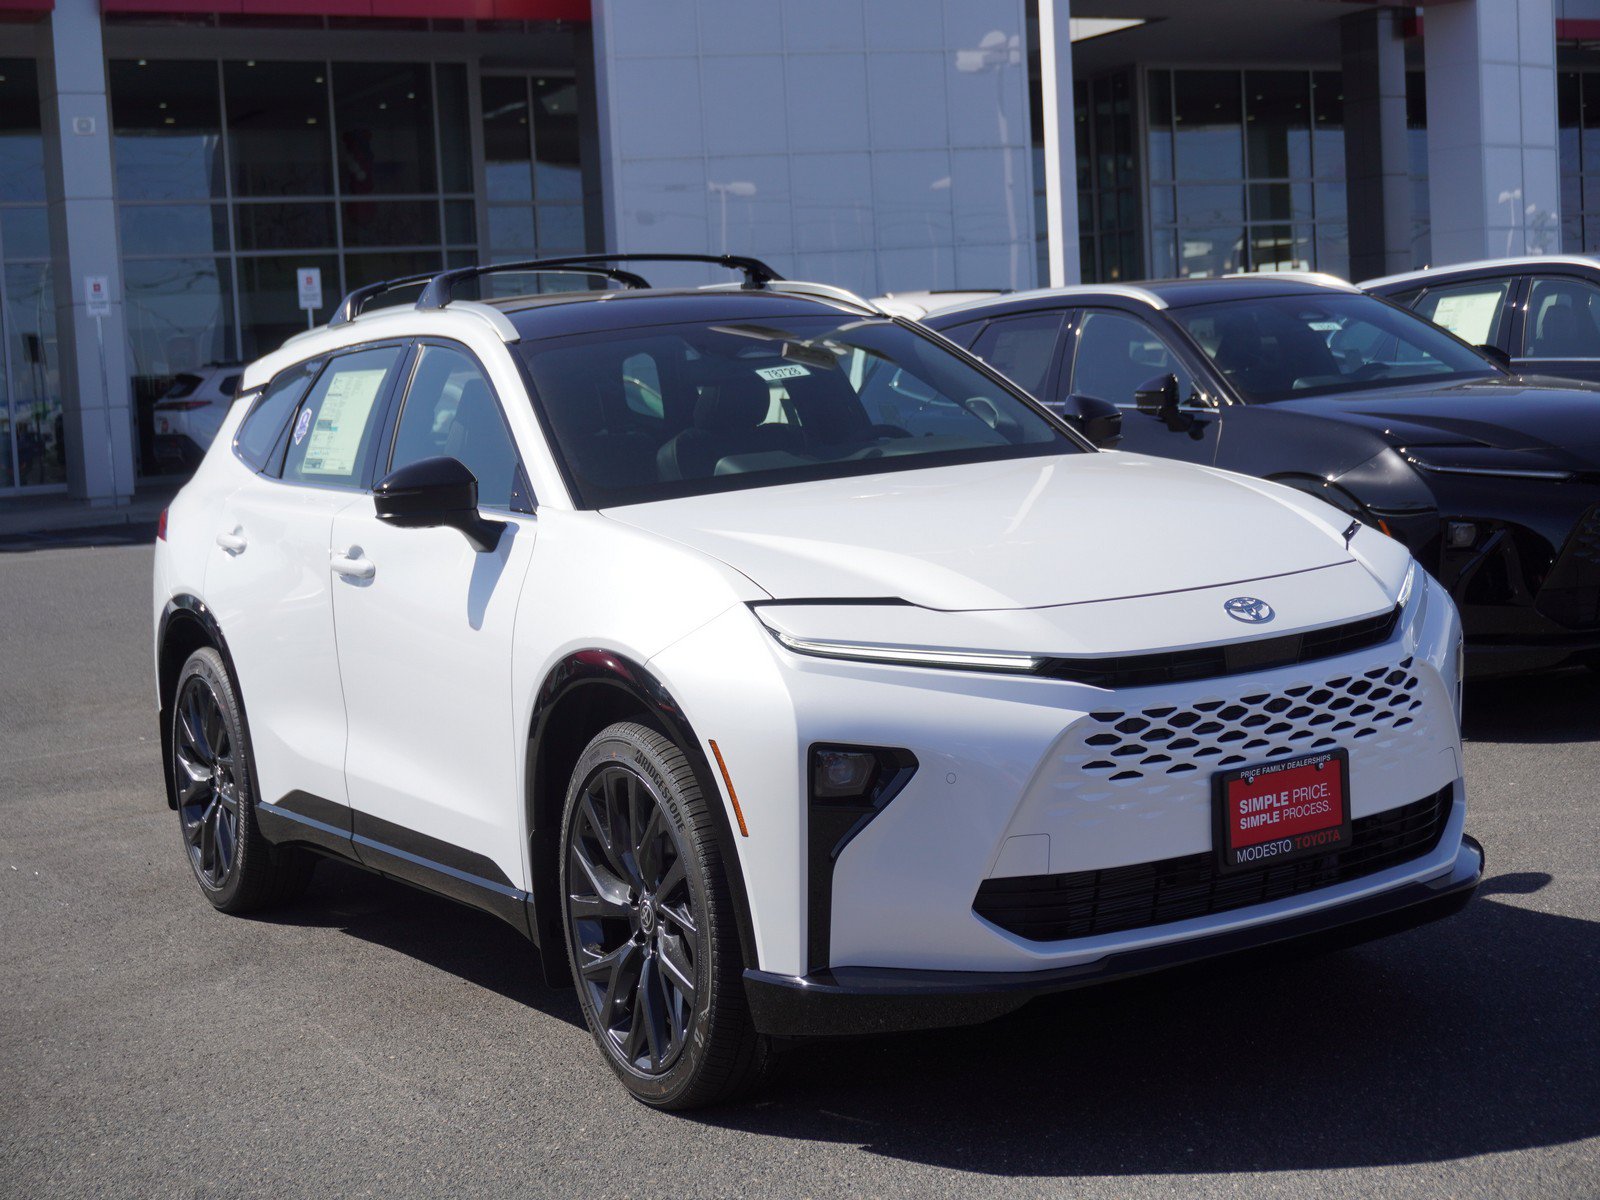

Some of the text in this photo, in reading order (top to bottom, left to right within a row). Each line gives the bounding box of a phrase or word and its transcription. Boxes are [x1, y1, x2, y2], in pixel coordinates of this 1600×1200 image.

[1240, 754, 1331, 778] PRICE FAMILY DEALERSHIPS
[634, 749, 686, 834] BRIDGESTONE
[1239, 782, 1331, 814] SIMPLE PRICE.
[1239, 800, 1332, 830] SIMPLE PROCESS.
[1236, 829, 1341, 863] MODESTO TOYOTA
